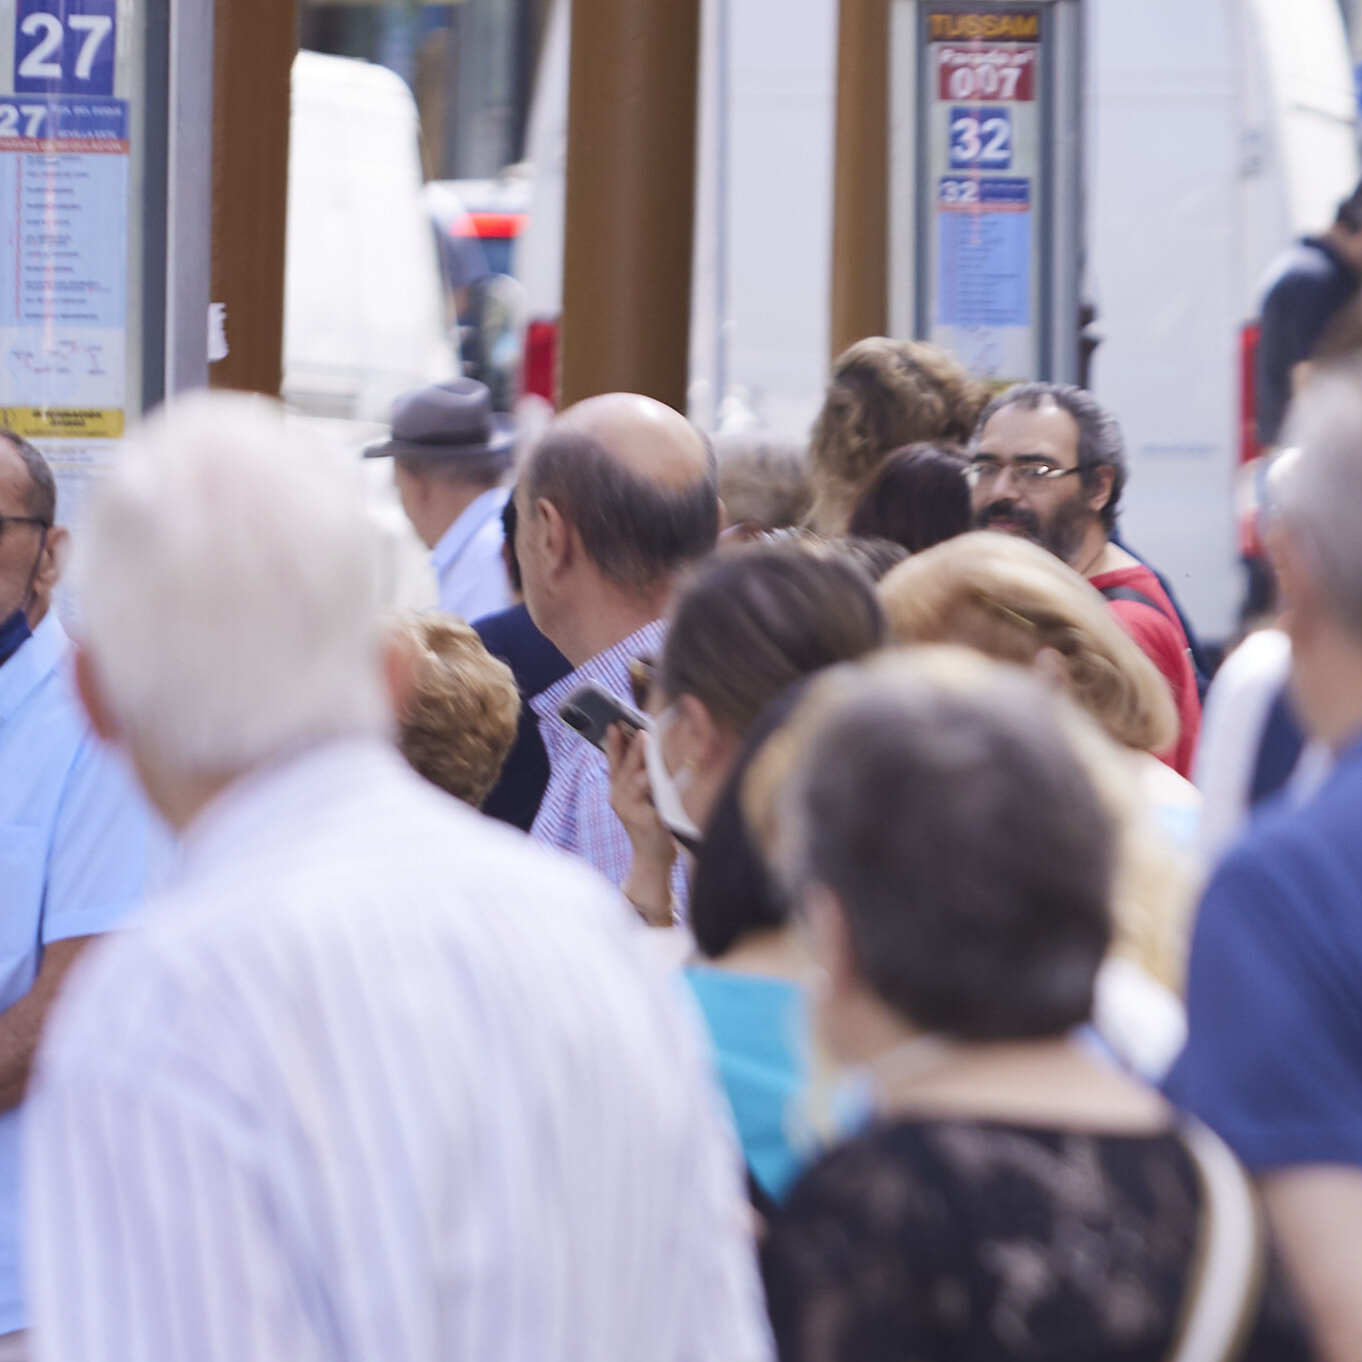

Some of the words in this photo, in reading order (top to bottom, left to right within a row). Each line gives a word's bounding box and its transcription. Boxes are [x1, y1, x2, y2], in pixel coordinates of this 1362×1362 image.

[929, 15, 1037, 36] TUSSAM
[18, 12, 112, 80] 27
[950, 63, 1021, 98] 007
[0, 104, 47, 138] 27
[951, 117, 1010, 160] 32
[940, 180, 979, 202] 32
